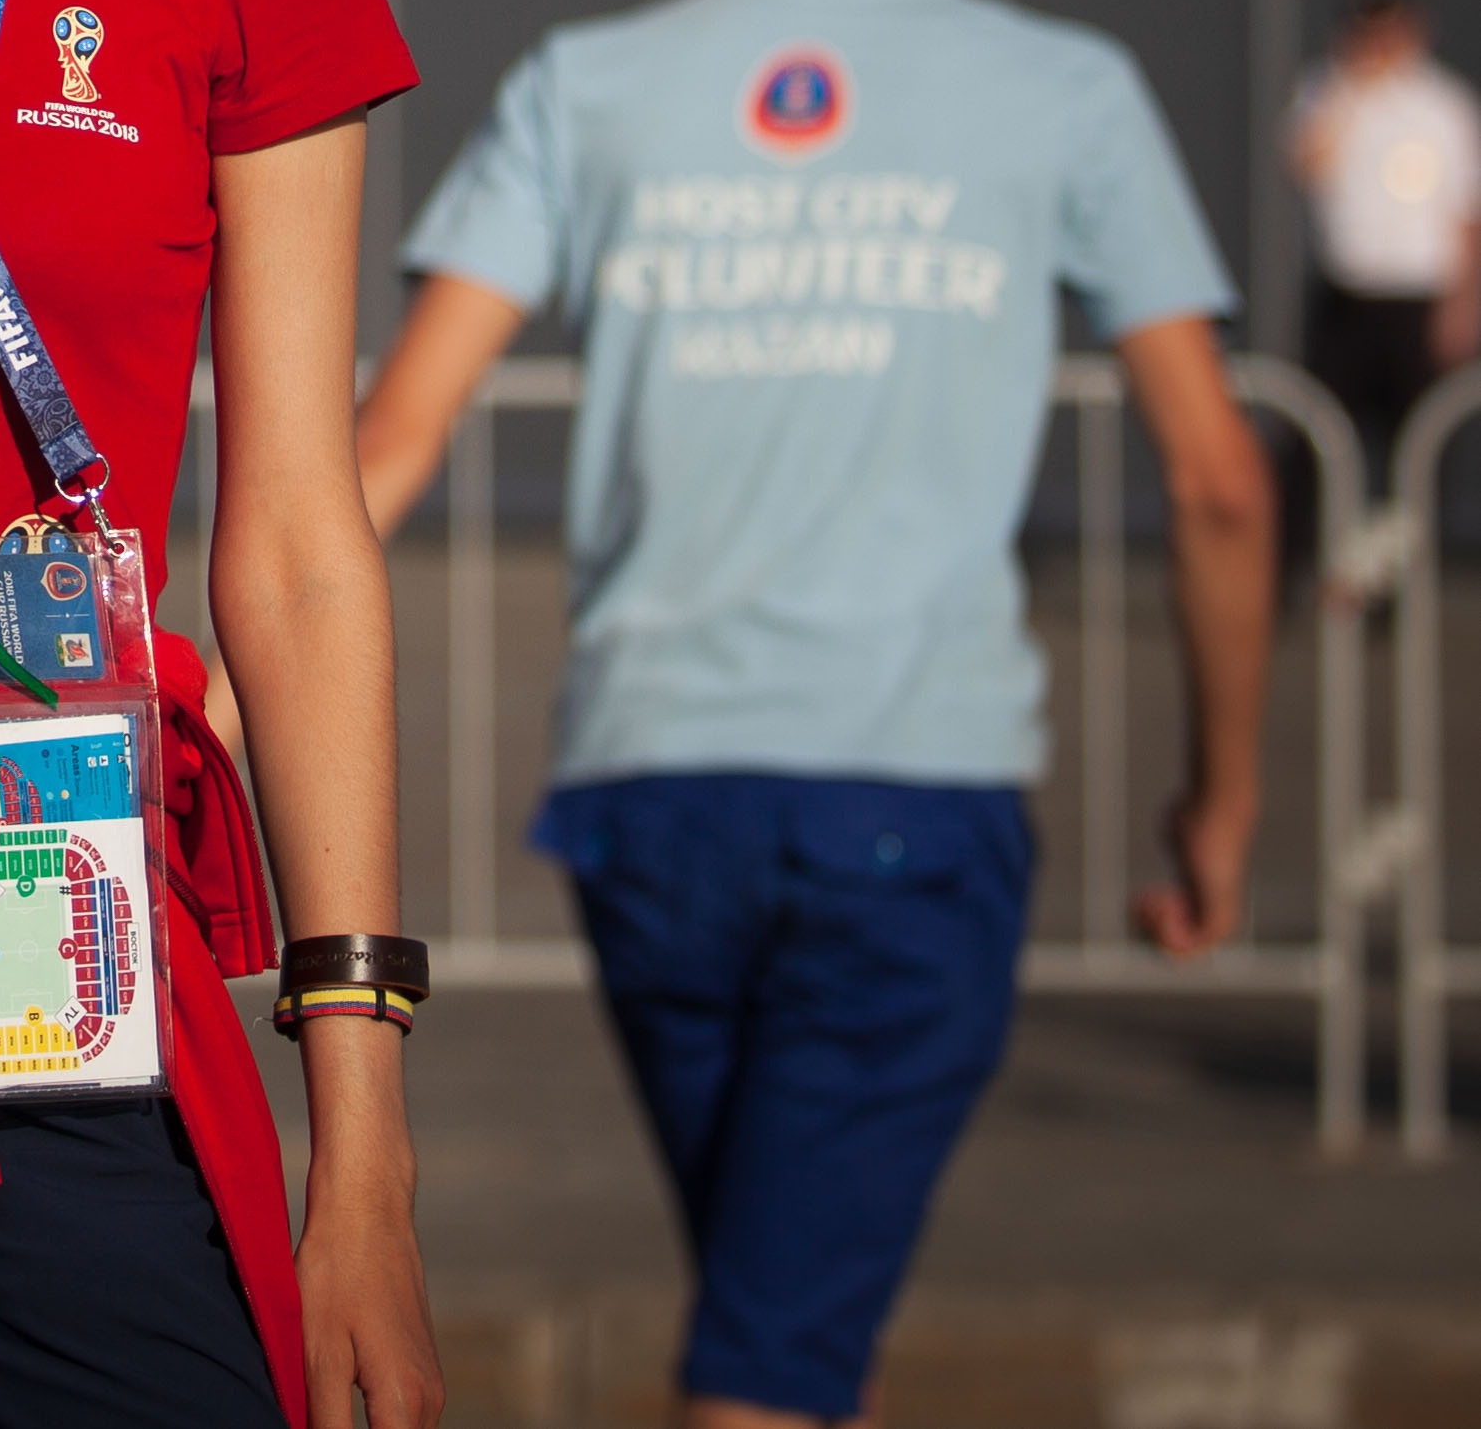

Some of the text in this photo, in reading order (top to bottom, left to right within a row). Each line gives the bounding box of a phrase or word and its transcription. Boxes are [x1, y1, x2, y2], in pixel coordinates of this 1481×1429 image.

[45, 102, 115, 120] FIFA WORLD CUP
[16, 109, 139, 143] RUSSIA 2018
[3, 570, 15, 595] 2018
[11, 624, 24, 665] WORLD
[65, 1007, 80, 1024] TV
